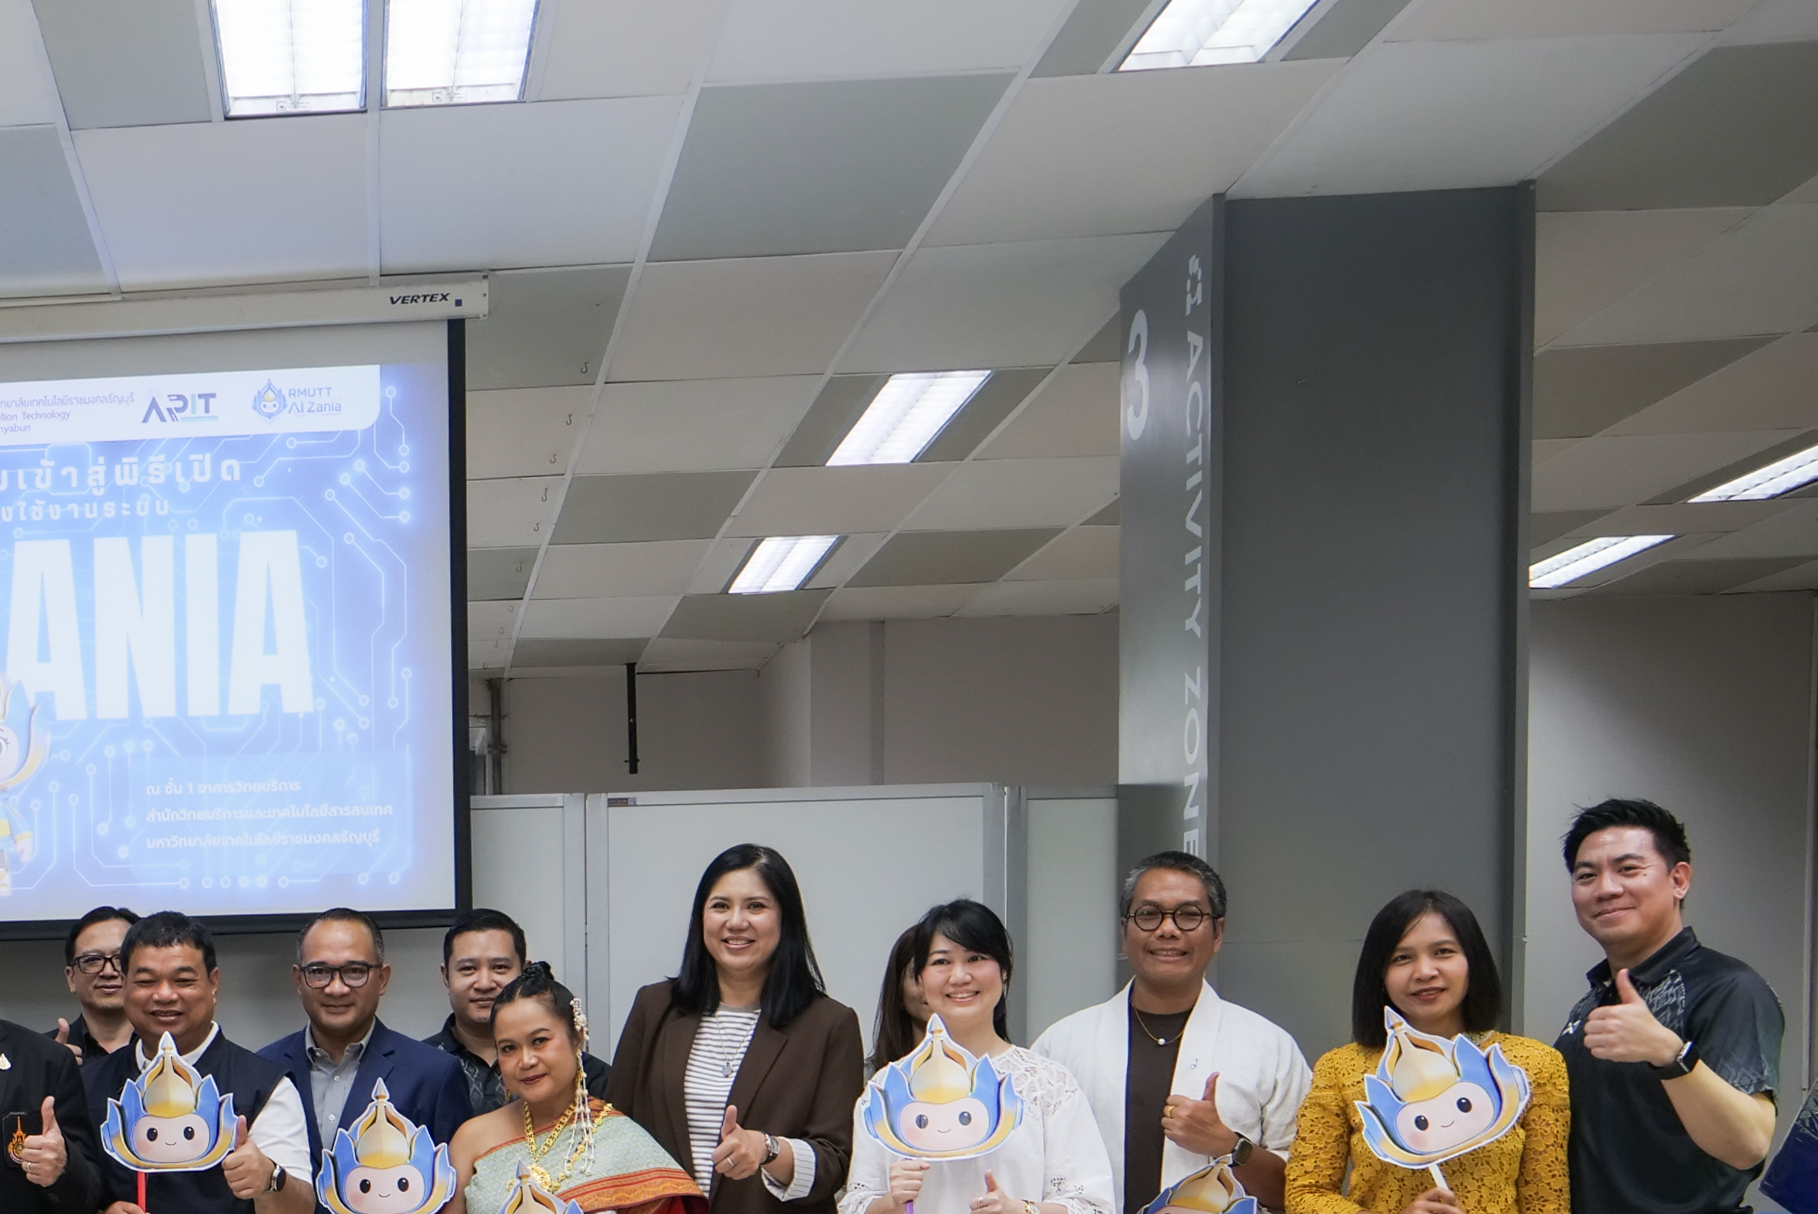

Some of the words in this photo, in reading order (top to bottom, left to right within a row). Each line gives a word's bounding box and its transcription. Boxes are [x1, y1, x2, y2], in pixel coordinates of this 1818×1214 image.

[389, 292, 450, 305] VERTEX
[1127, 309, 1149, 440] 3
[288, 387, 332, 398] RMUTT
[288, 401, 304, 414] AI
[308, 401, 342, 412] Zania
[22, 410, 71, 422] Technology
[1185, 330, 1204, 638] ACTIVITY
[1183, 666, 1201, 858] ZONE
[146, 785, 160, 796] ณ
[164, 777, 183, 795] ชั้น
[187, 781, 194, 794] 1
